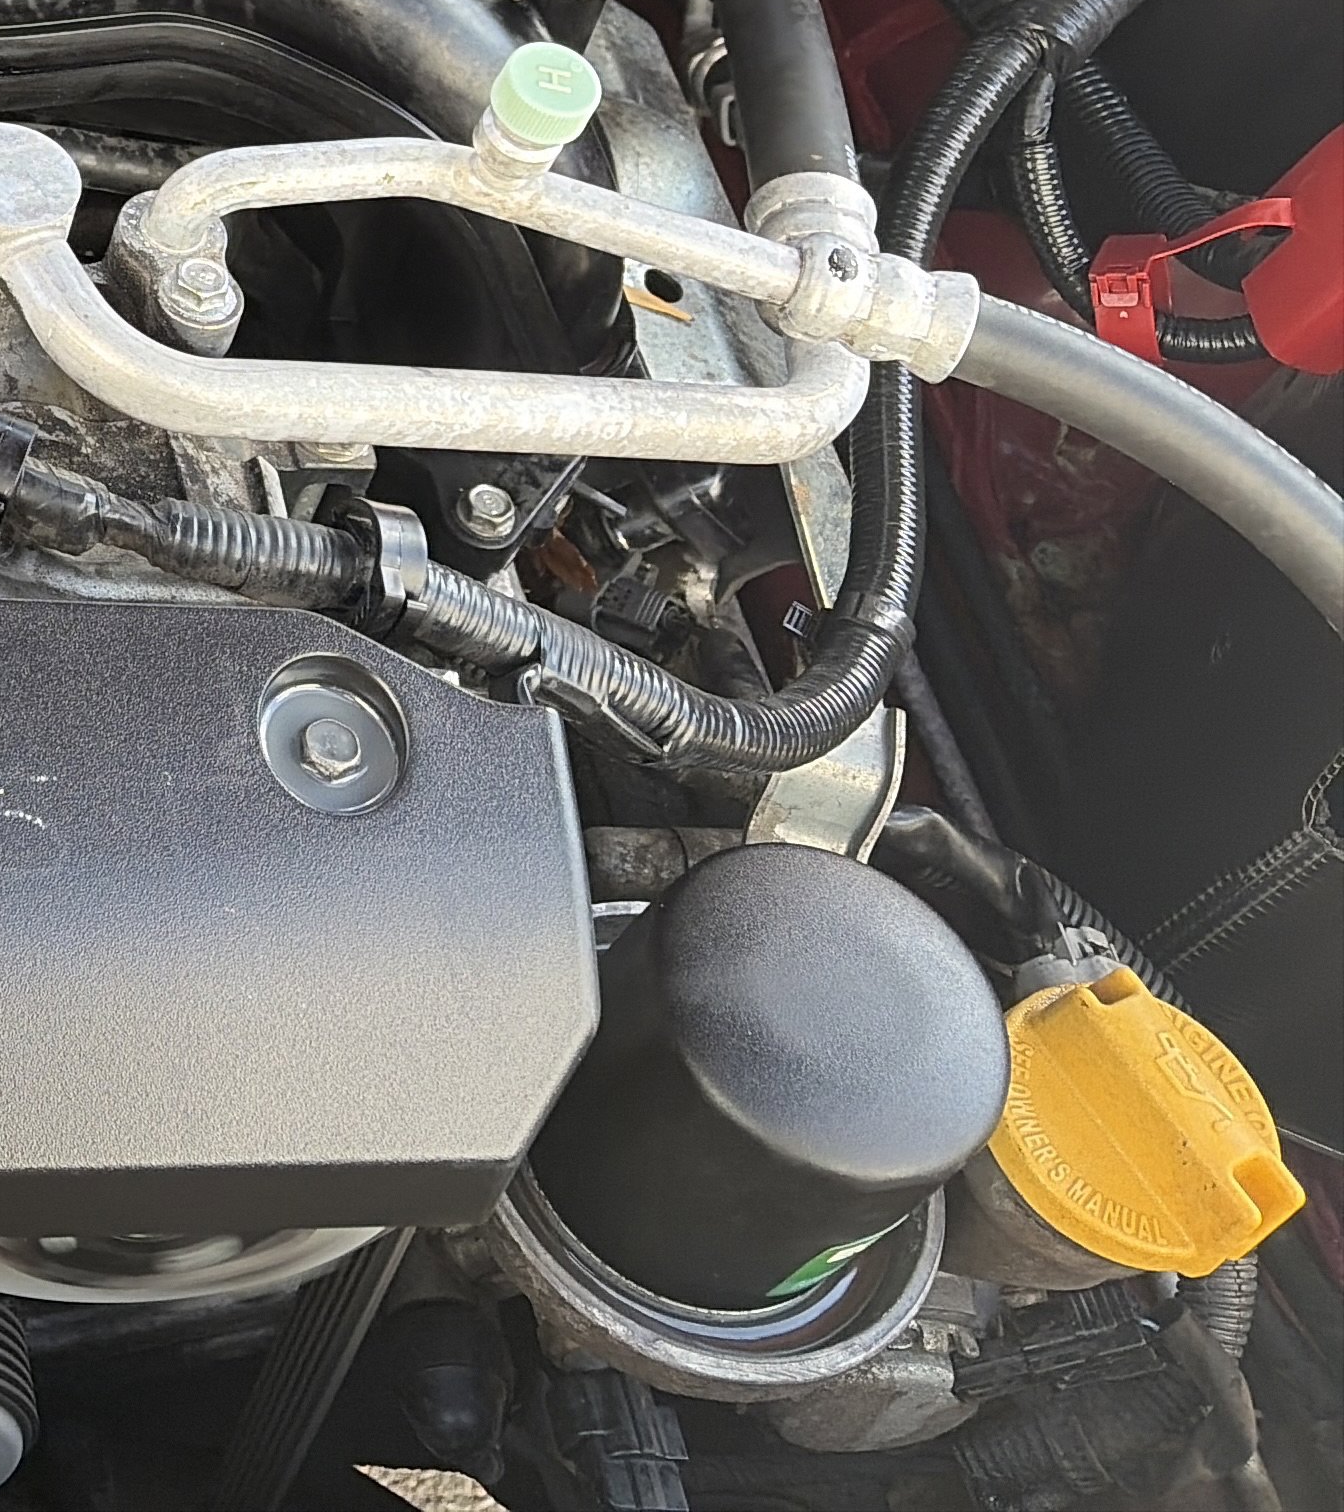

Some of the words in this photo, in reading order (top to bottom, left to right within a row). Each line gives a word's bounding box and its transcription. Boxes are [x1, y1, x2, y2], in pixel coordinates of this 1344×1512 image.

[537, 65, 573, 95] H
[1013, 1040, 1034, 1083] SEE
[1009, 1083, 1070, 1183] OWNER'S
[1067, 1177, 1169, 1246] MANUAL
